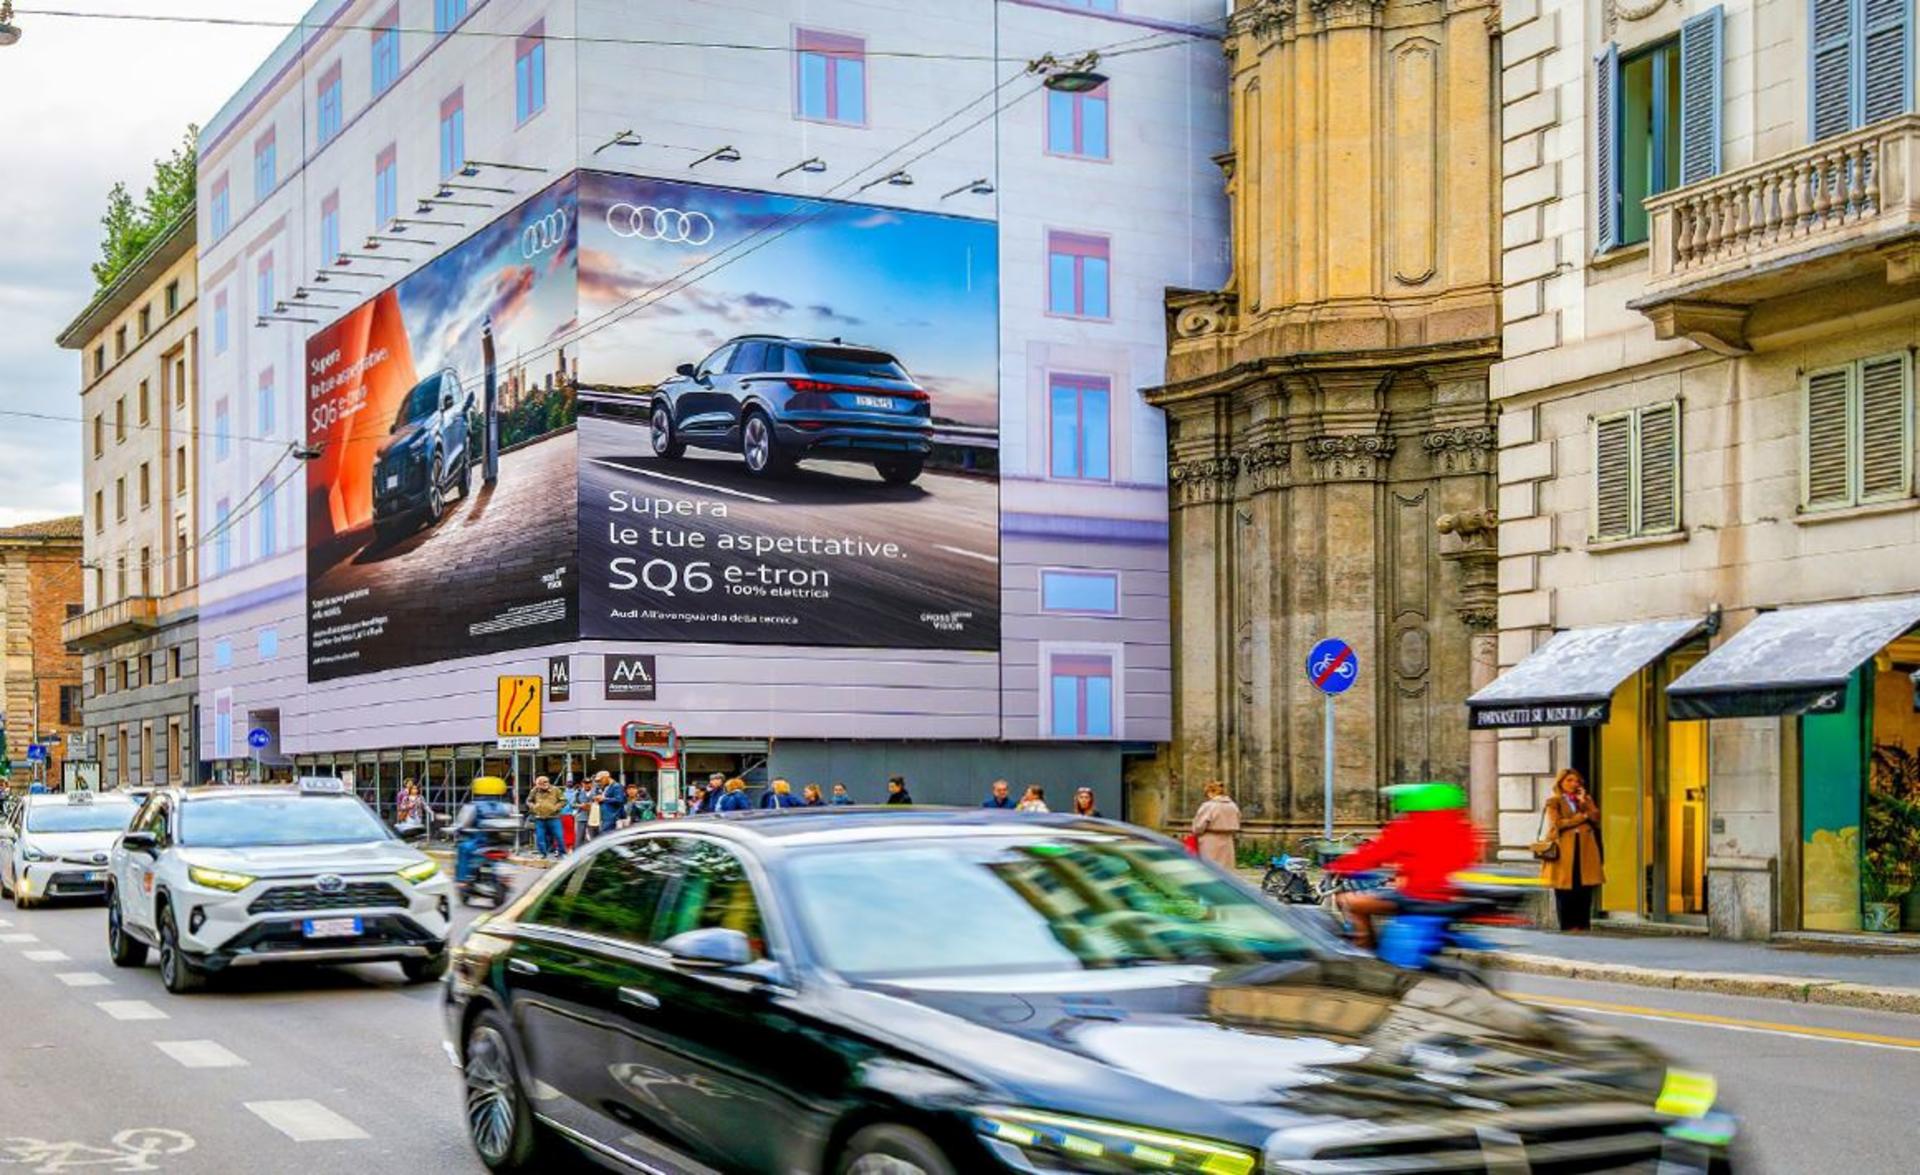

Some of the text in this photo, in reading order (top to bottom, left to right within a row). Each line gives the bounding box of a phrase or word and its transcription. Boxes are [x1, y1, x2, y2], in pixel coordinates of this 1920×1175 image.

[608, 490, 728, 520] Supera
[609, 523, 908, 559] le tue aspettative.
[608, 557, 830, 597] SQ6 e-tron
[725, 584, 830, 598] 100% elettrica
[610, 609, 638, 618] Audi
